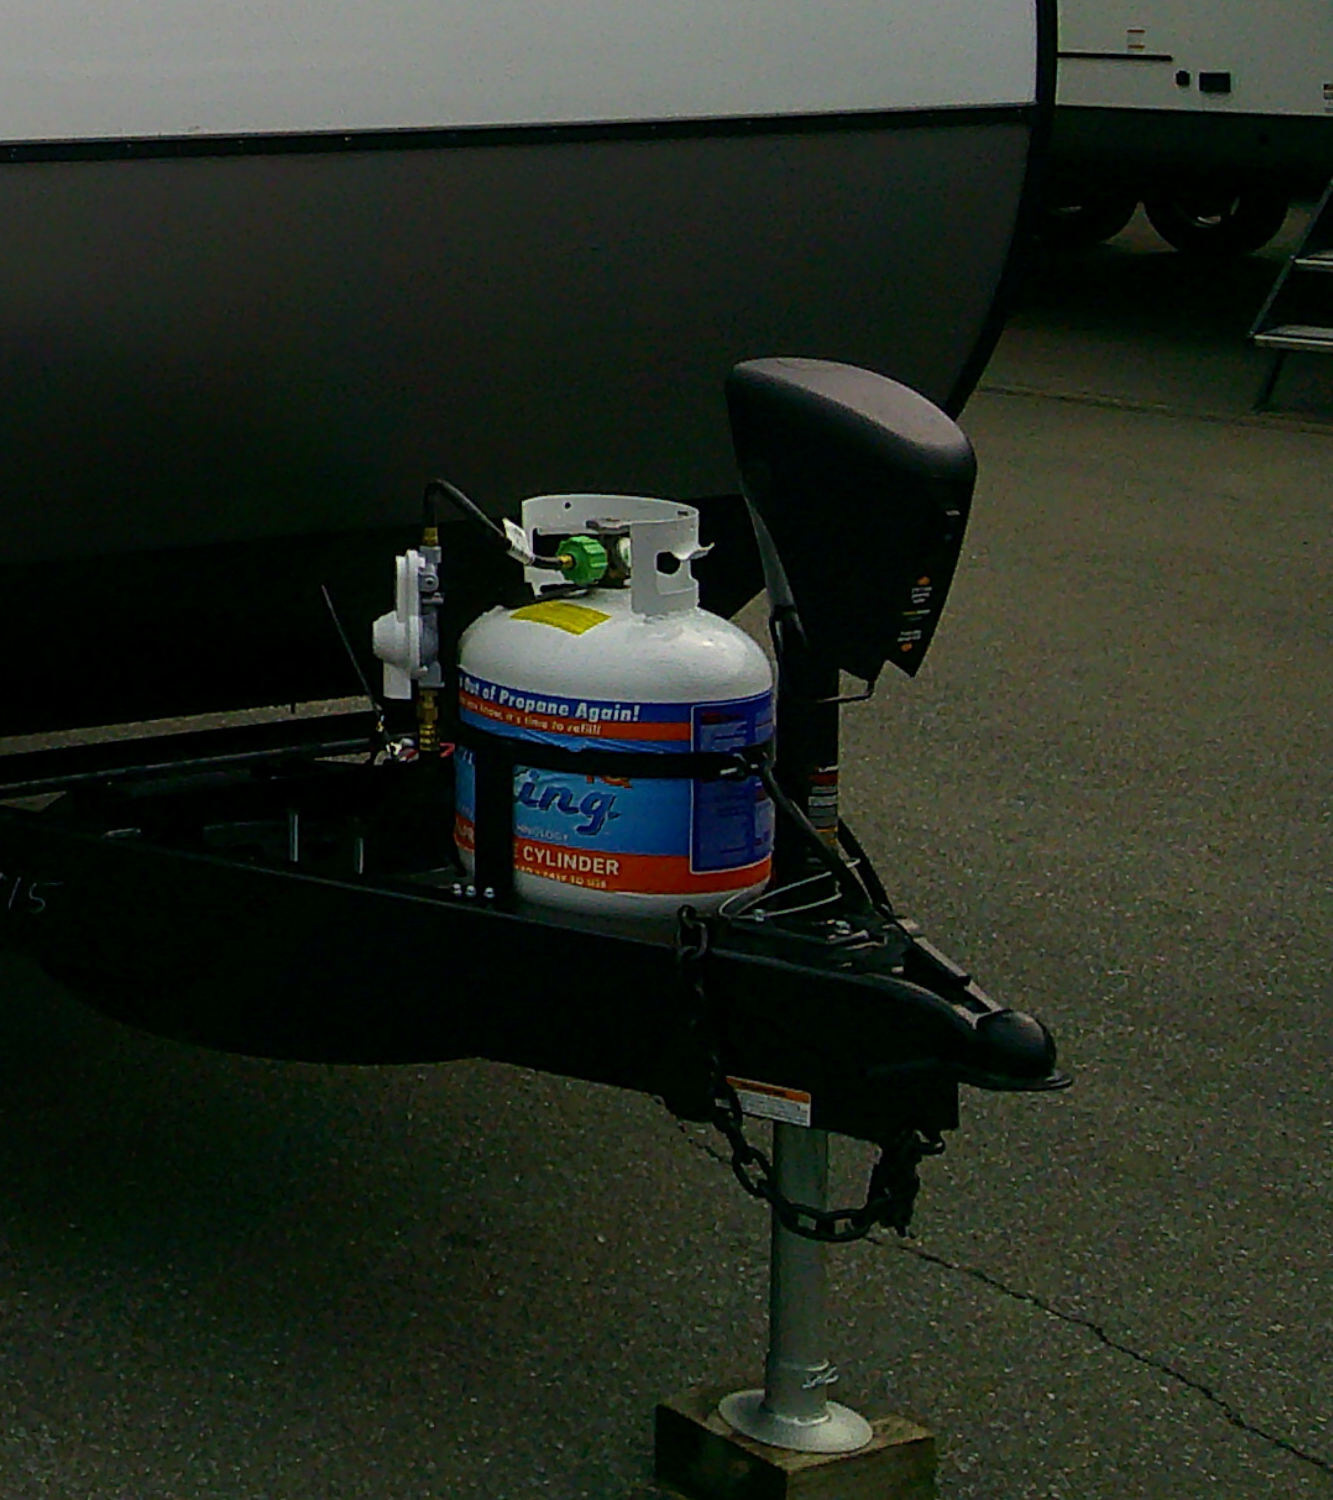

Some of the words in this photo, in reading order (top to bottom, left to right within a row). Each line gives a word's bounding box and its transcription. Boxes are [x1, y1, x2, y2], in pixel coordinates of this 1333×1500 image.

[482, 685, 496, 700] of
[499, 688, 570, 717] Propane
[574, 702, 641, 722] Again!
[551, 720, 564, 732] to
[515, 767, 620, 837] ing
[522, 845, 620, 877] CYLINDER
